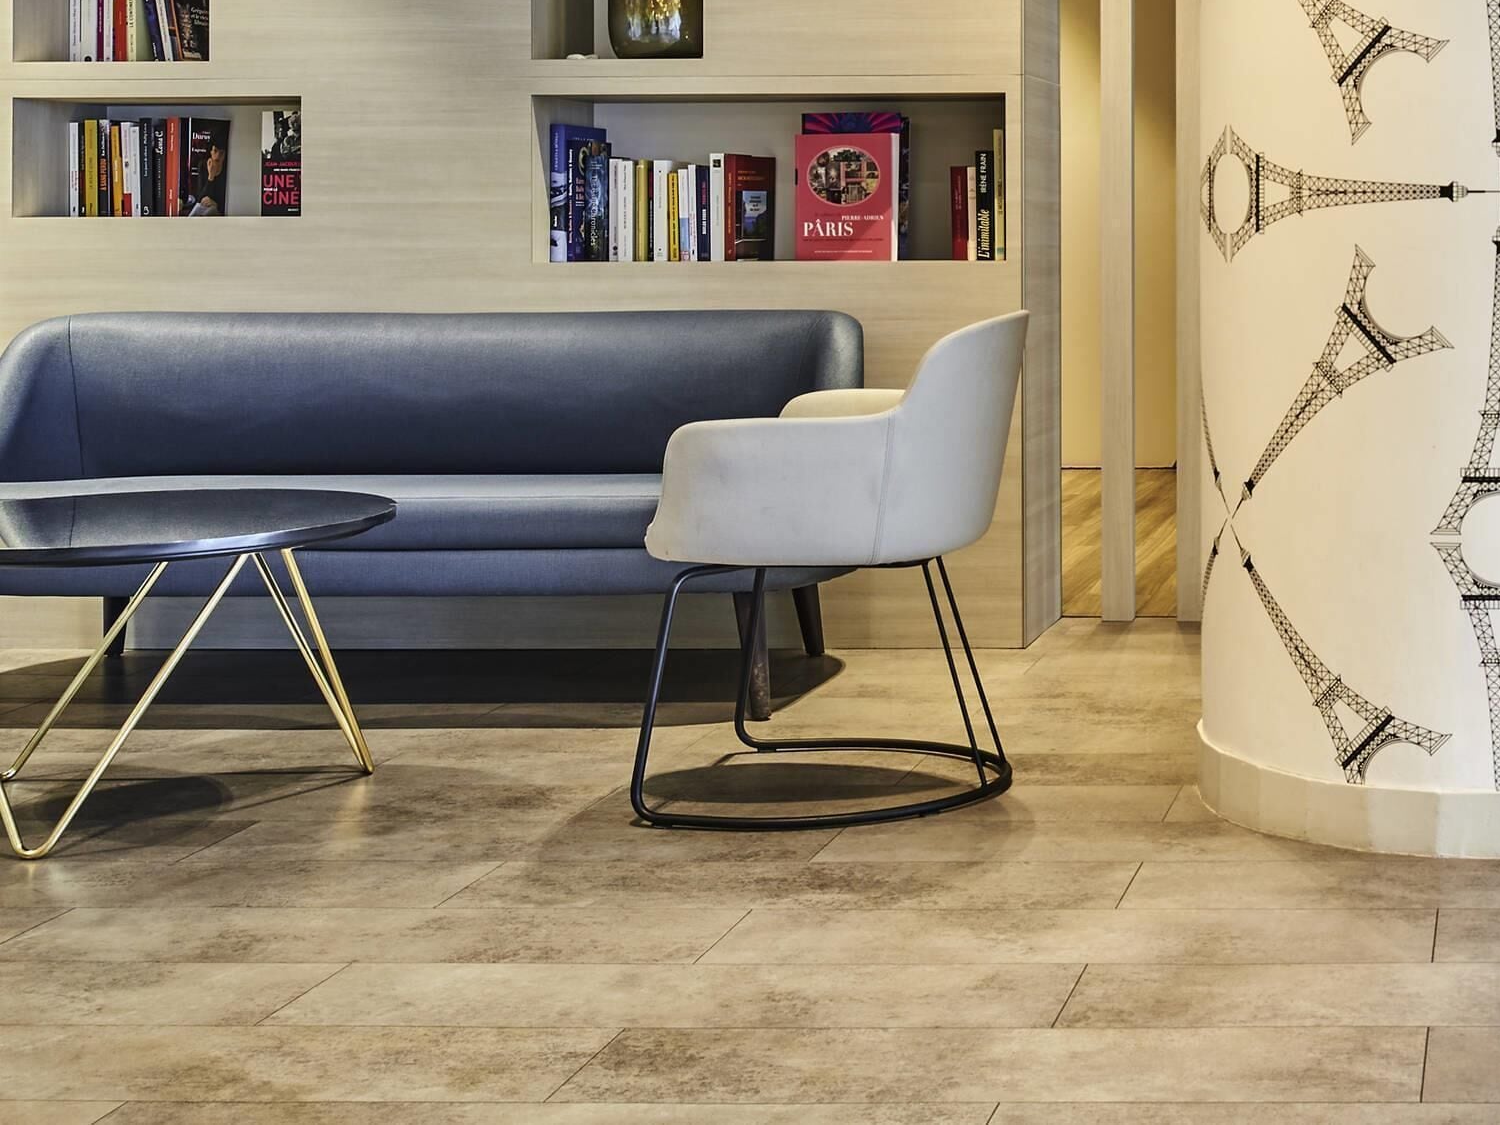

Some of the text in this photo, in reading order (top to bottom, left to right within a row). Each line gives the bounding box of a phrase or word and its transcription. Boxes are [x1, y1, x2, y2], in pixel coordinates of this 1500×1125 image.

[263, 175, 295, 187] UNE
[263, 187, 299, 205] CINÉ
[803, 219, 854, 237] PÂRIS
[977, 209, 990, 258] L'inimitable
